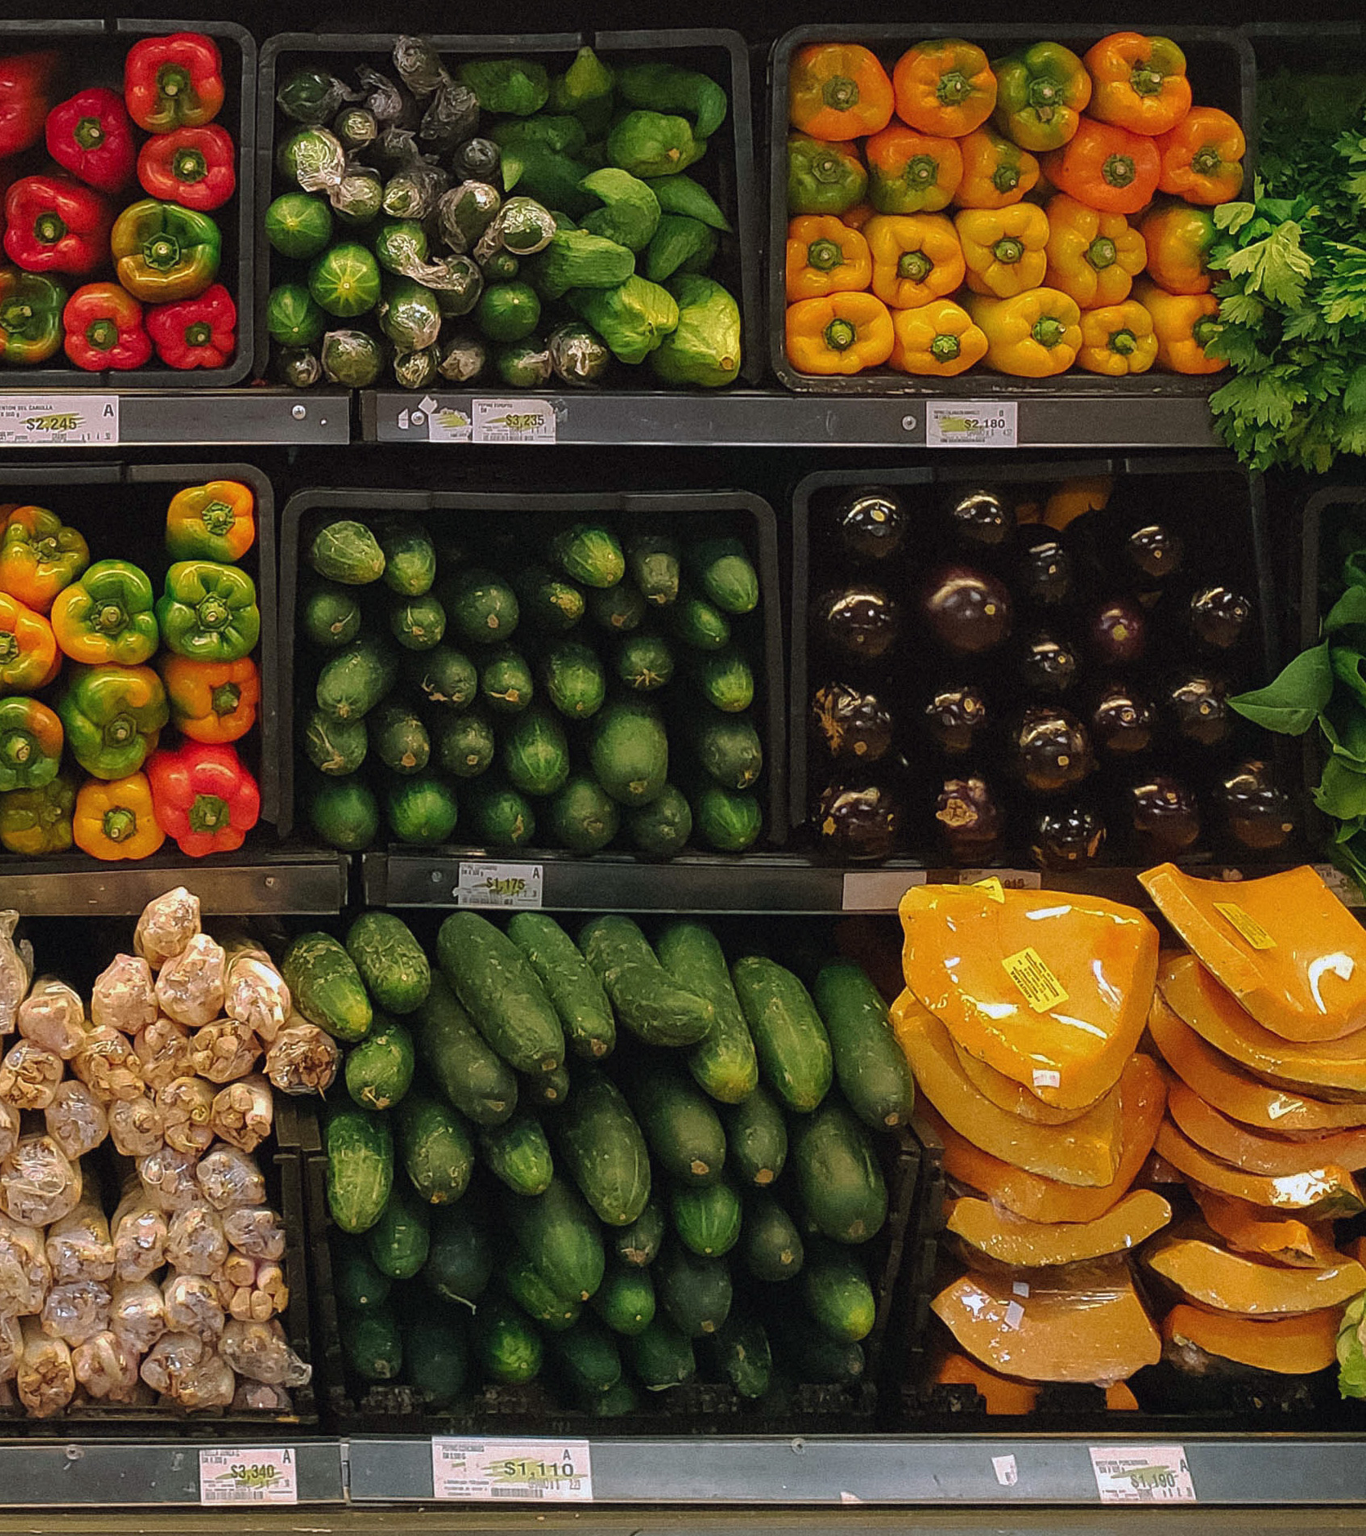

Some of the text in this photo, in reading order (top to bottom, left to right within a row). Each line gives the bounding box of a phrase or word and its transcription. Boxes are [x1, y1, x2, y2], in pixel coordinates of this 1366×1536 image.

[103, 404, 114, 417] A
[26, 417, 77, 433] $2,245
[505, 414, 545, 429] $3,235
[964, 418, 1006, 430] $2,180
[533, 867, 540, 879] A
[486, 876, 526, 892] $1,175
[283, 1449, 291, 1463] A
[562, 1449, 572, 1461] A
[230, 1464, 275, 1480] $3,340
[504, 1461, 575, 1477] $1,110
[1179, 1459, 1190, 1472] A
[1130, 1473, 1176, 1490] $1,190
